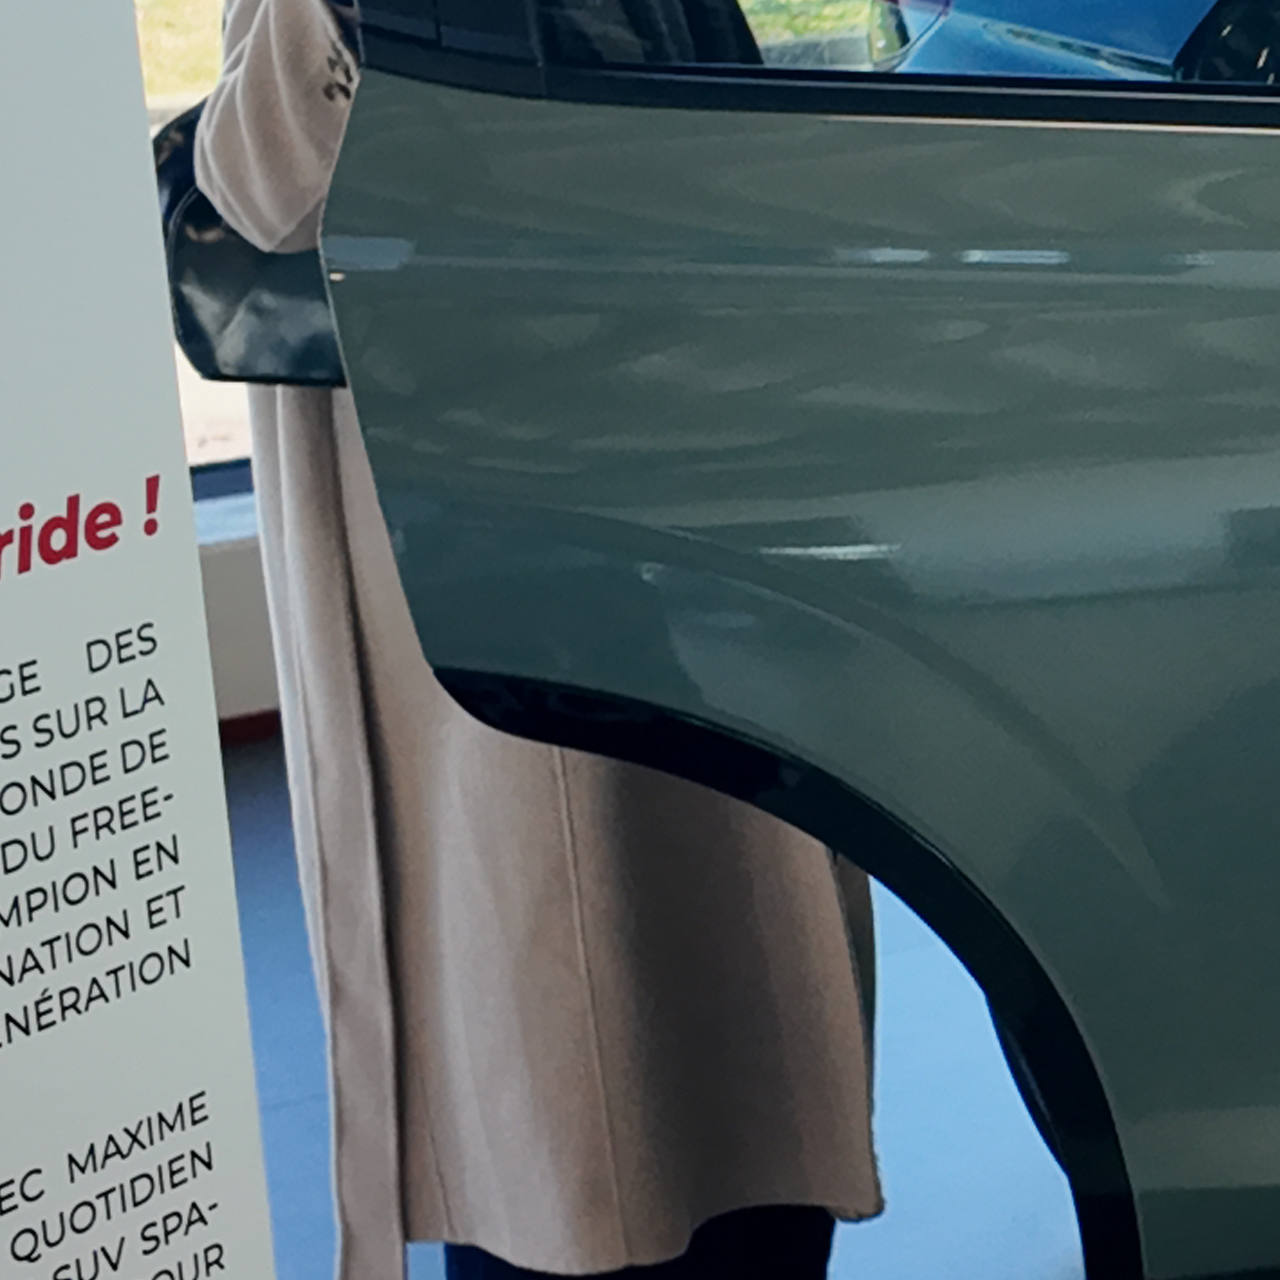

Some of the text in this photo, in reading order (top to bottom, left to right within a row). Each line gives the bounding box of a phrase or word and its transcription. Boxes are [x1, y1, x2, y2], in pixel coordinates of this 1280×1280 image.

[143, 474, 160, 536] !
[86, 622, 157, 673] DES
[0, 678, 165, 759] S SUR LA
[0, 728, 170, 815] ONDE DE
[1, 786, 174, 875] DU FREE-
[133, 834, 180, 880] EN
[146, 885, 185, 929] ET
[0, 938, 191, 1048] NÉRATION
[0, 1090, 209, 1216] EC MAXIME
[10, 1141, 213, 1263] QUOTIDIEN
[140, 1201, 218, 1256] SPA-
